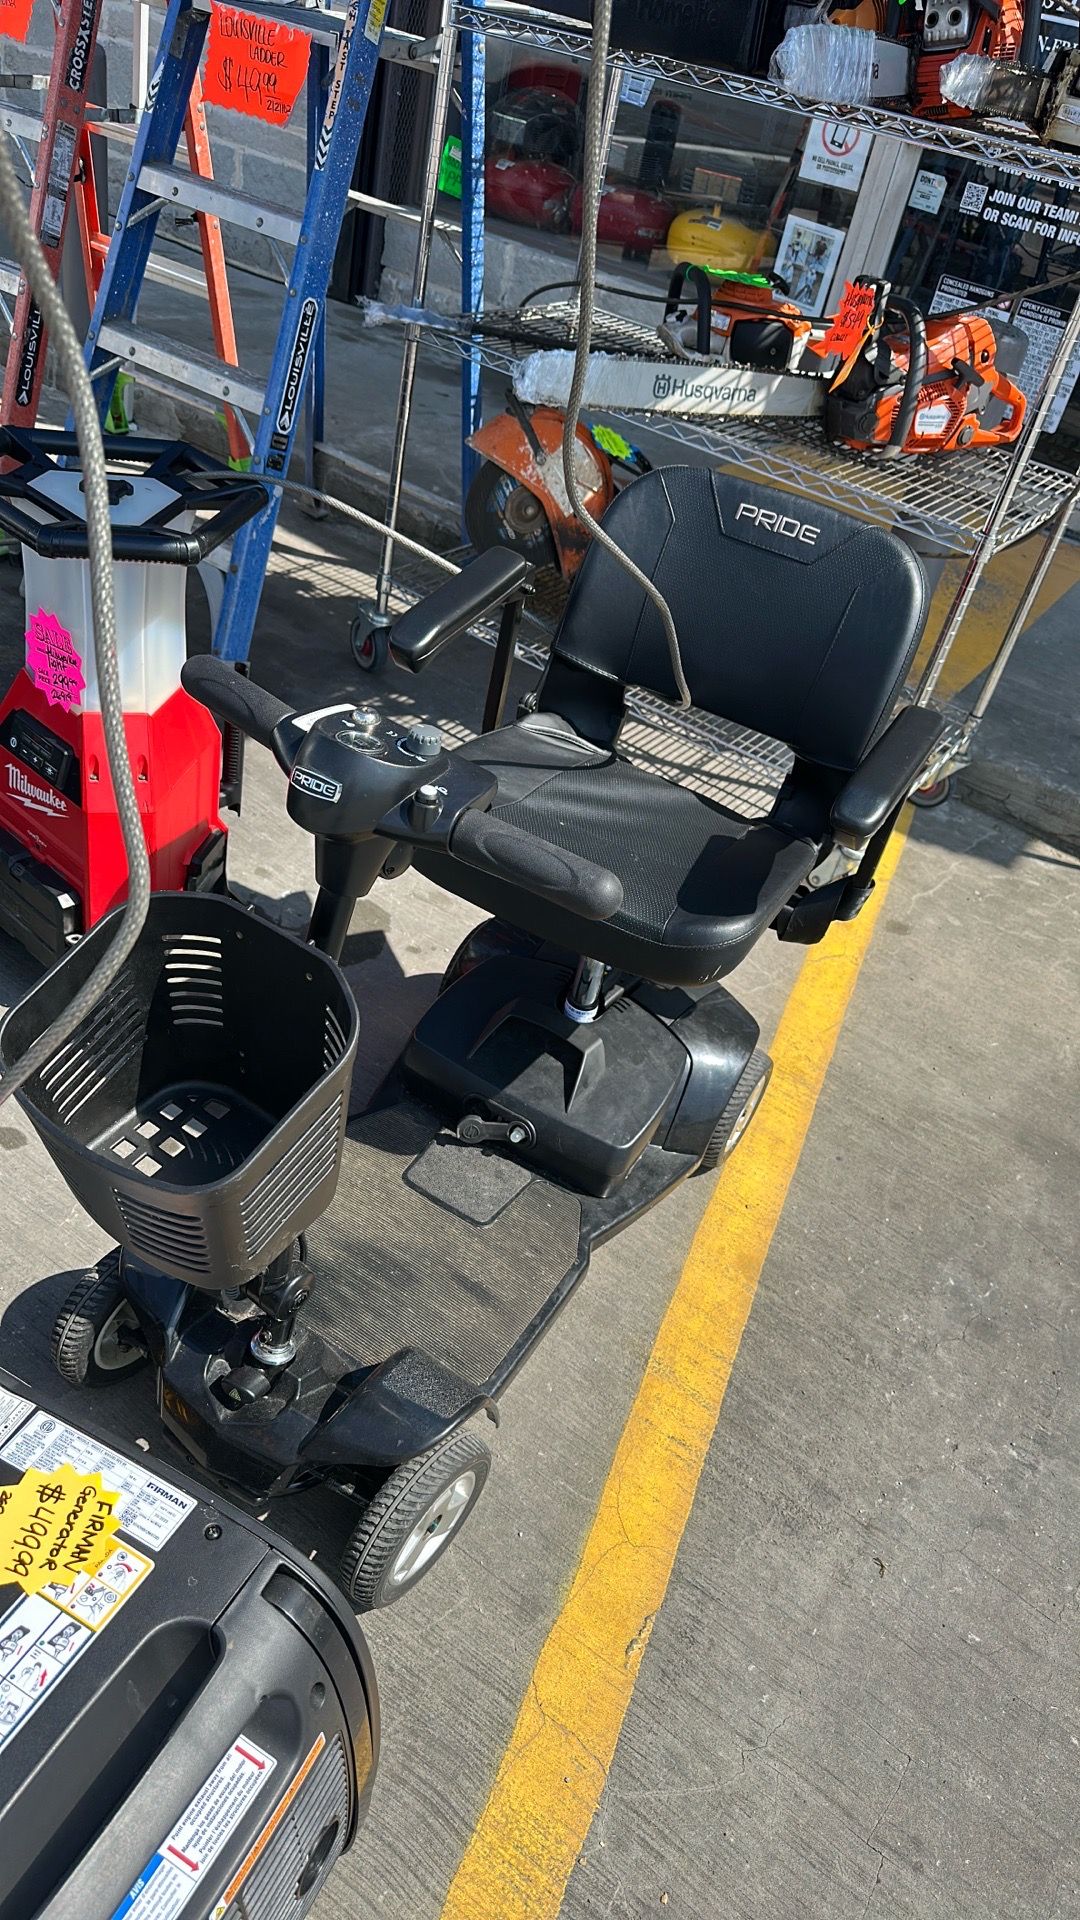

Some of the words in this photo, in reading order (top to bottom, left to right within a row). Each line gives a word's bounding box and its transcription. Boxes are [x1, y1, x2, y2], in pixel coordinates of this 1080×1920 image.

[69, 0, 94, 90] CROSSXSTE
[219, 13, 277, 47] LOUISVILLE
[250, 45, 288, 68] LADDER
[328, 80, 341, 119] STEP
[983, 208, 1000, 222] OR
[1000, 213, 1032, 231] SCAN
[1033, 222, 1057, 238] FOR
[988, 189, 1016, 206] JOIN
[1017, 197, 1042, 213] OUR
[1042, 204, 1079, 224] TEAM!
[943, 278, 969, 290] CONCEALED
[969, 285, 995, 297] HANDGUNS
[1022, 302, 1040, 311] OPENLY
[1040, 307, 1061, 318] CARRIED
[22, 308, 42, 391] LOUISVILL
[285, 301, 316, 410] LOUISVILLE
[671, 378, 757, 403] Husqvarna
[735, 502, 821, 545] PRIDE
[4, 763, 68, 811] Milwaukee
[294, 770, 336, 797] PRIDE
[146, 1482, 188, 1510] FIRMAN
[171, 1825, 183, 1840] Point
[182, 1808, 196, 1826] engine
[193, 1787, 210, 1808] exhaust
[208, 1774, 219, 1787] away
[217, 1761, 227, 1774] from
[181, 1828, 200, 1853] Mantenga
[204, 1806, 215, 1820] gases
[218, 1782, 232, 1799] escape
[189, 1802, 207, 1826] occupied
[199, 1834, 214, 1854] Pointer
[242, 1771, 255, 1789] moteur
[229, 1794, 248, 1820] structures
[128, 1878, 145, 1900] AVIS
